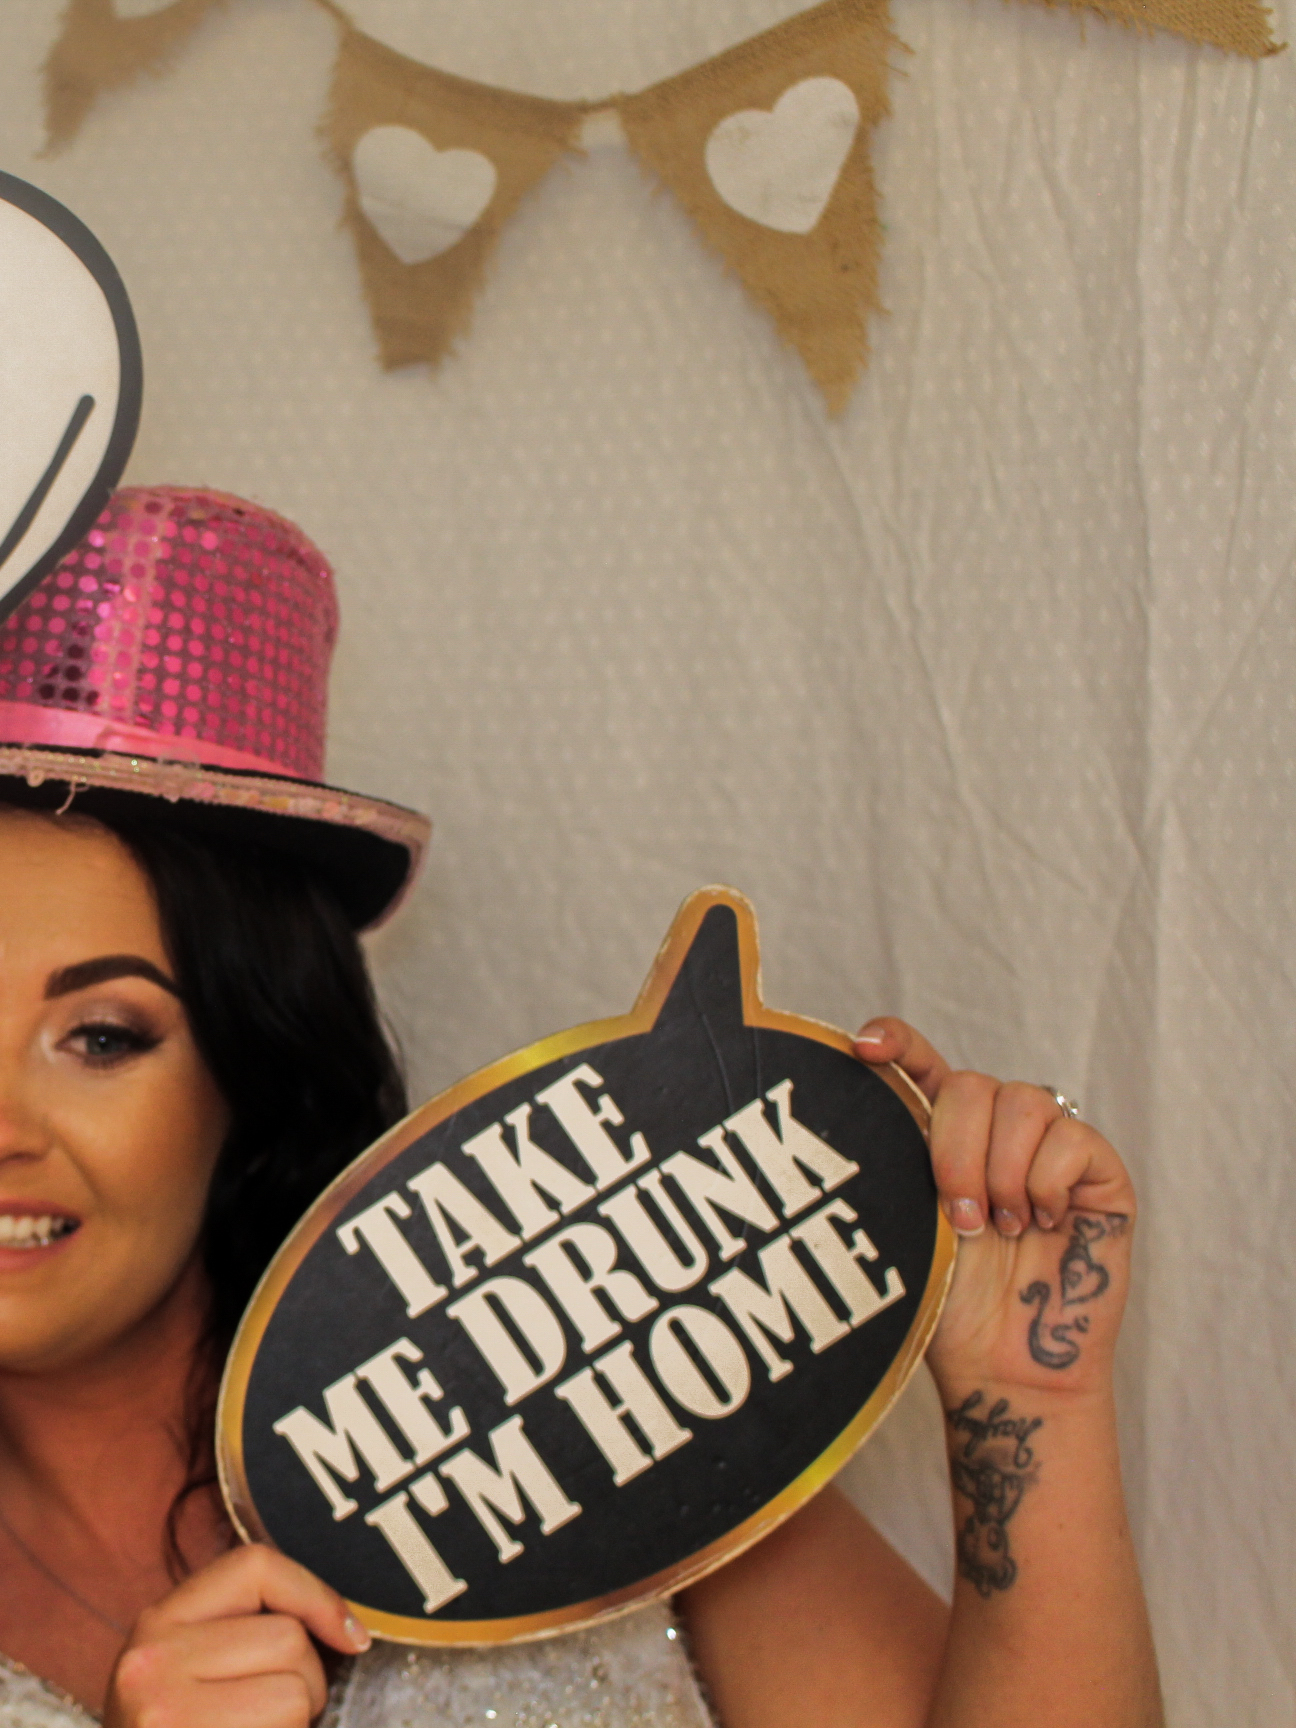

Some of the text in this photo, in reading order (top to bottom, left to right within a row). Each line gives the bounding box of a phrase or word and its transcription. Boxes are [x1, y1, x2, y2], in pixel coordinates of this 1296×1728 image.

[272, 1078, 860, 1521] ME DRUNK
[335, 1062, 652, 1319] TAKE
[364, 1197, 906, 1614] I'M HOME
